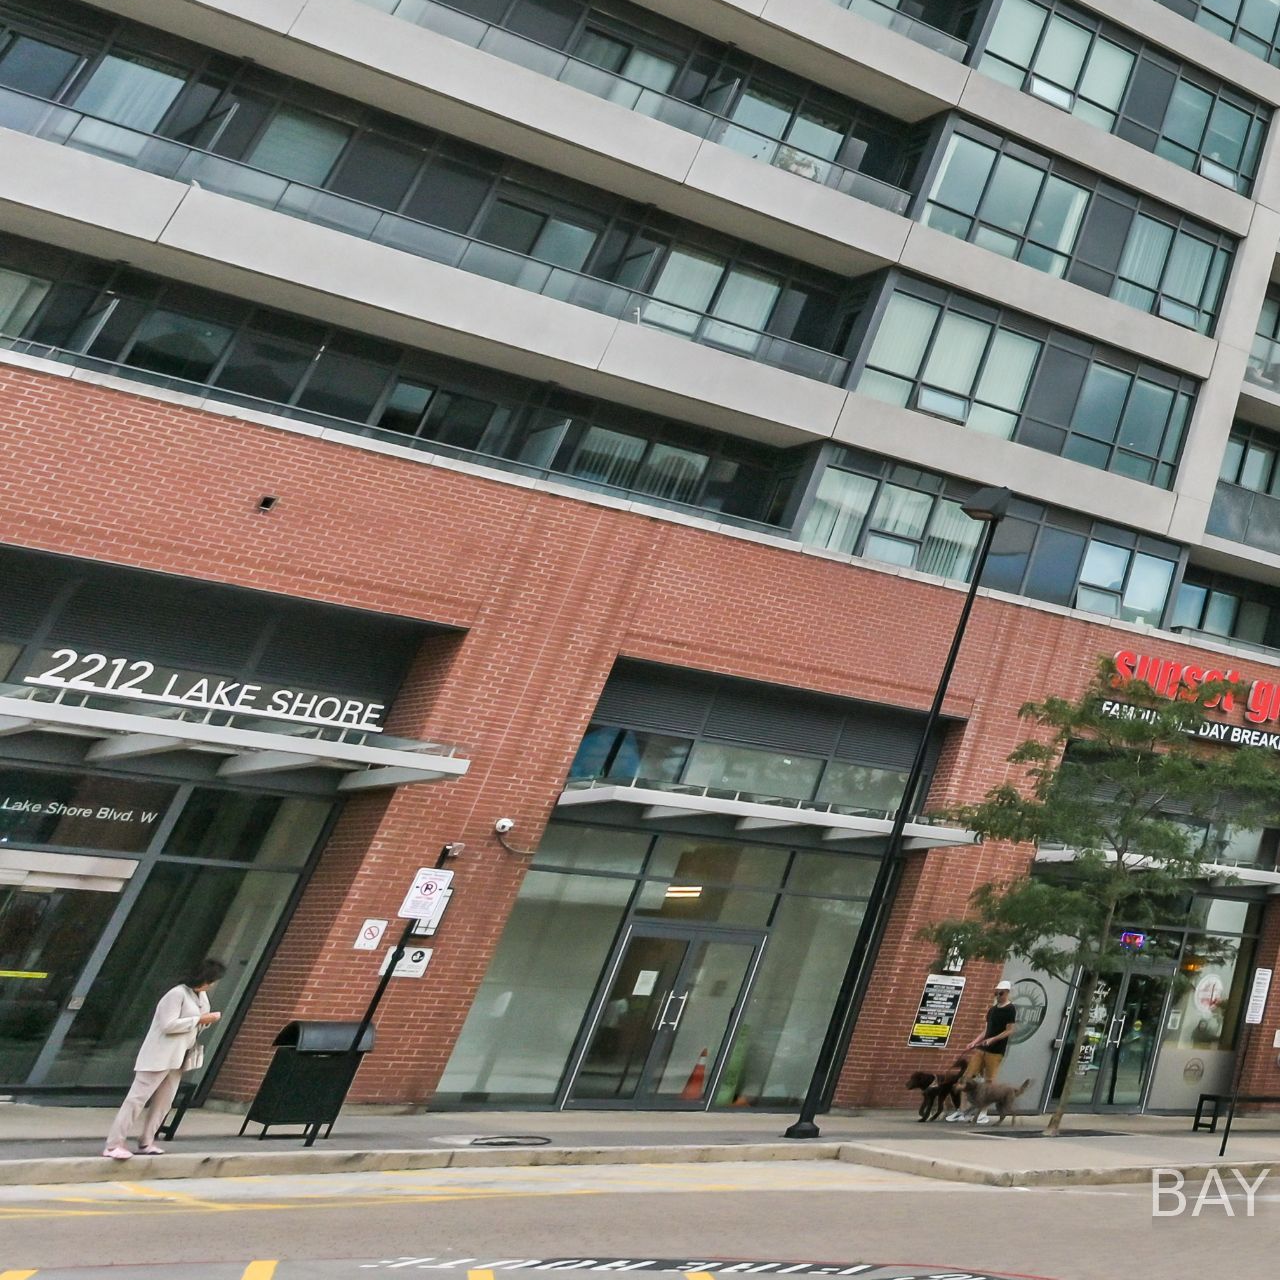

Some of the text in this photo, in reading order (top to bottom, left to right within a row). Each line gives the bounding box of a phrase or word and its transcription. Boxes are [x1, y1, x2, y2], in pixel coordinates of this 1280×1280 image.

[38, 648, 384, 728] 2212 LAKE SHORE
[1199, 722, 1232, 740] DAY
[1, 796, 158, 824] Lake Shore Blvd. W
